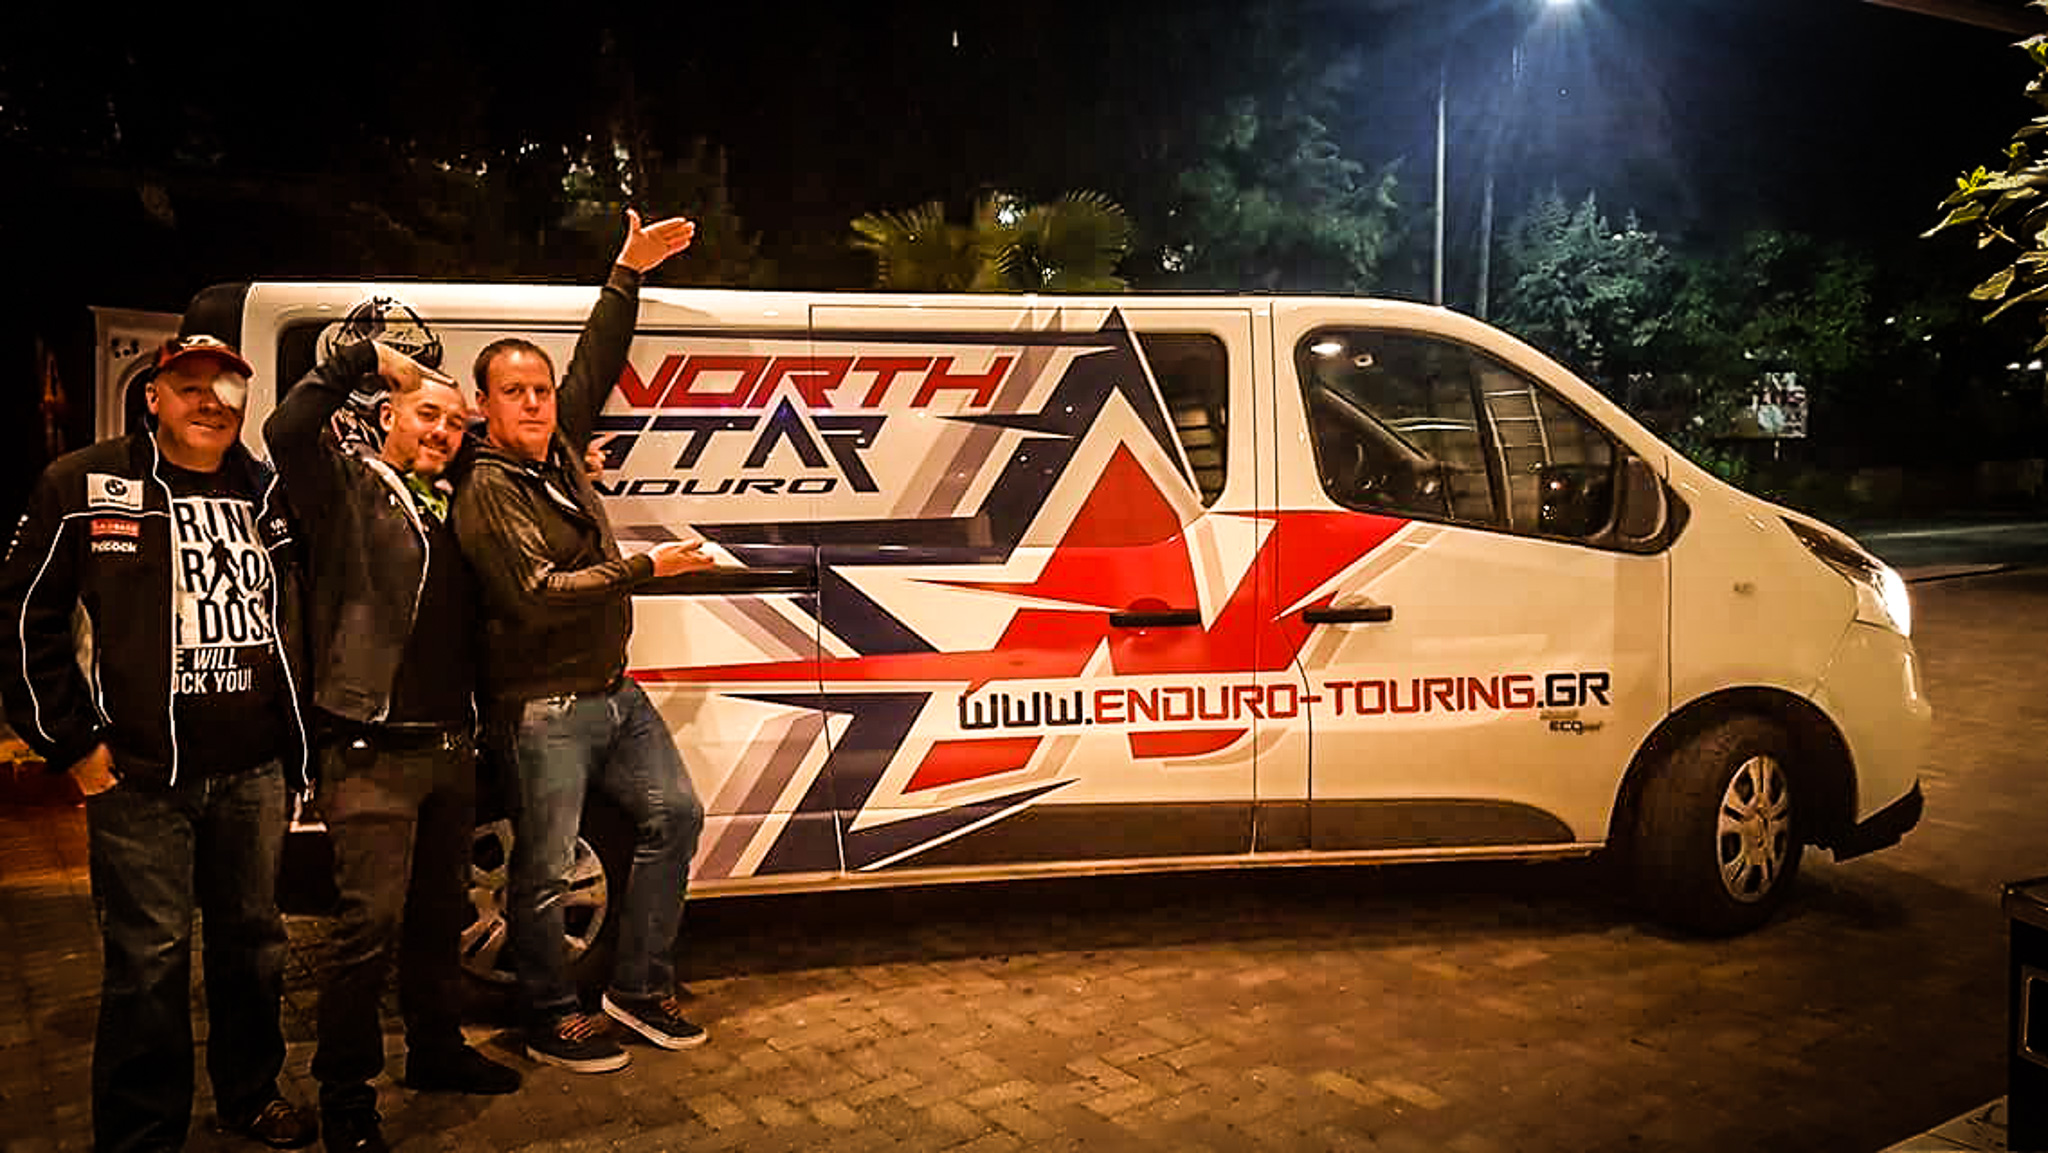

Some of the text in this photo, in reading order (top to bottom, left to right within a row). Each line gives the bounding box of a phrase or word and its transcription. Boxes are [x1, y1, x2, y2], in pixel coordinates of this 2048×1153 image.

[619, 355, 1014, 409] NORTH
[591, 478, 838, 497] NDURO
[193, 647, 238, 671] WILL
[172, 667, 252, 695] OCK YOU!
[959, 671, 1611, 730] WWW.ENDURO-TOURING.GR
